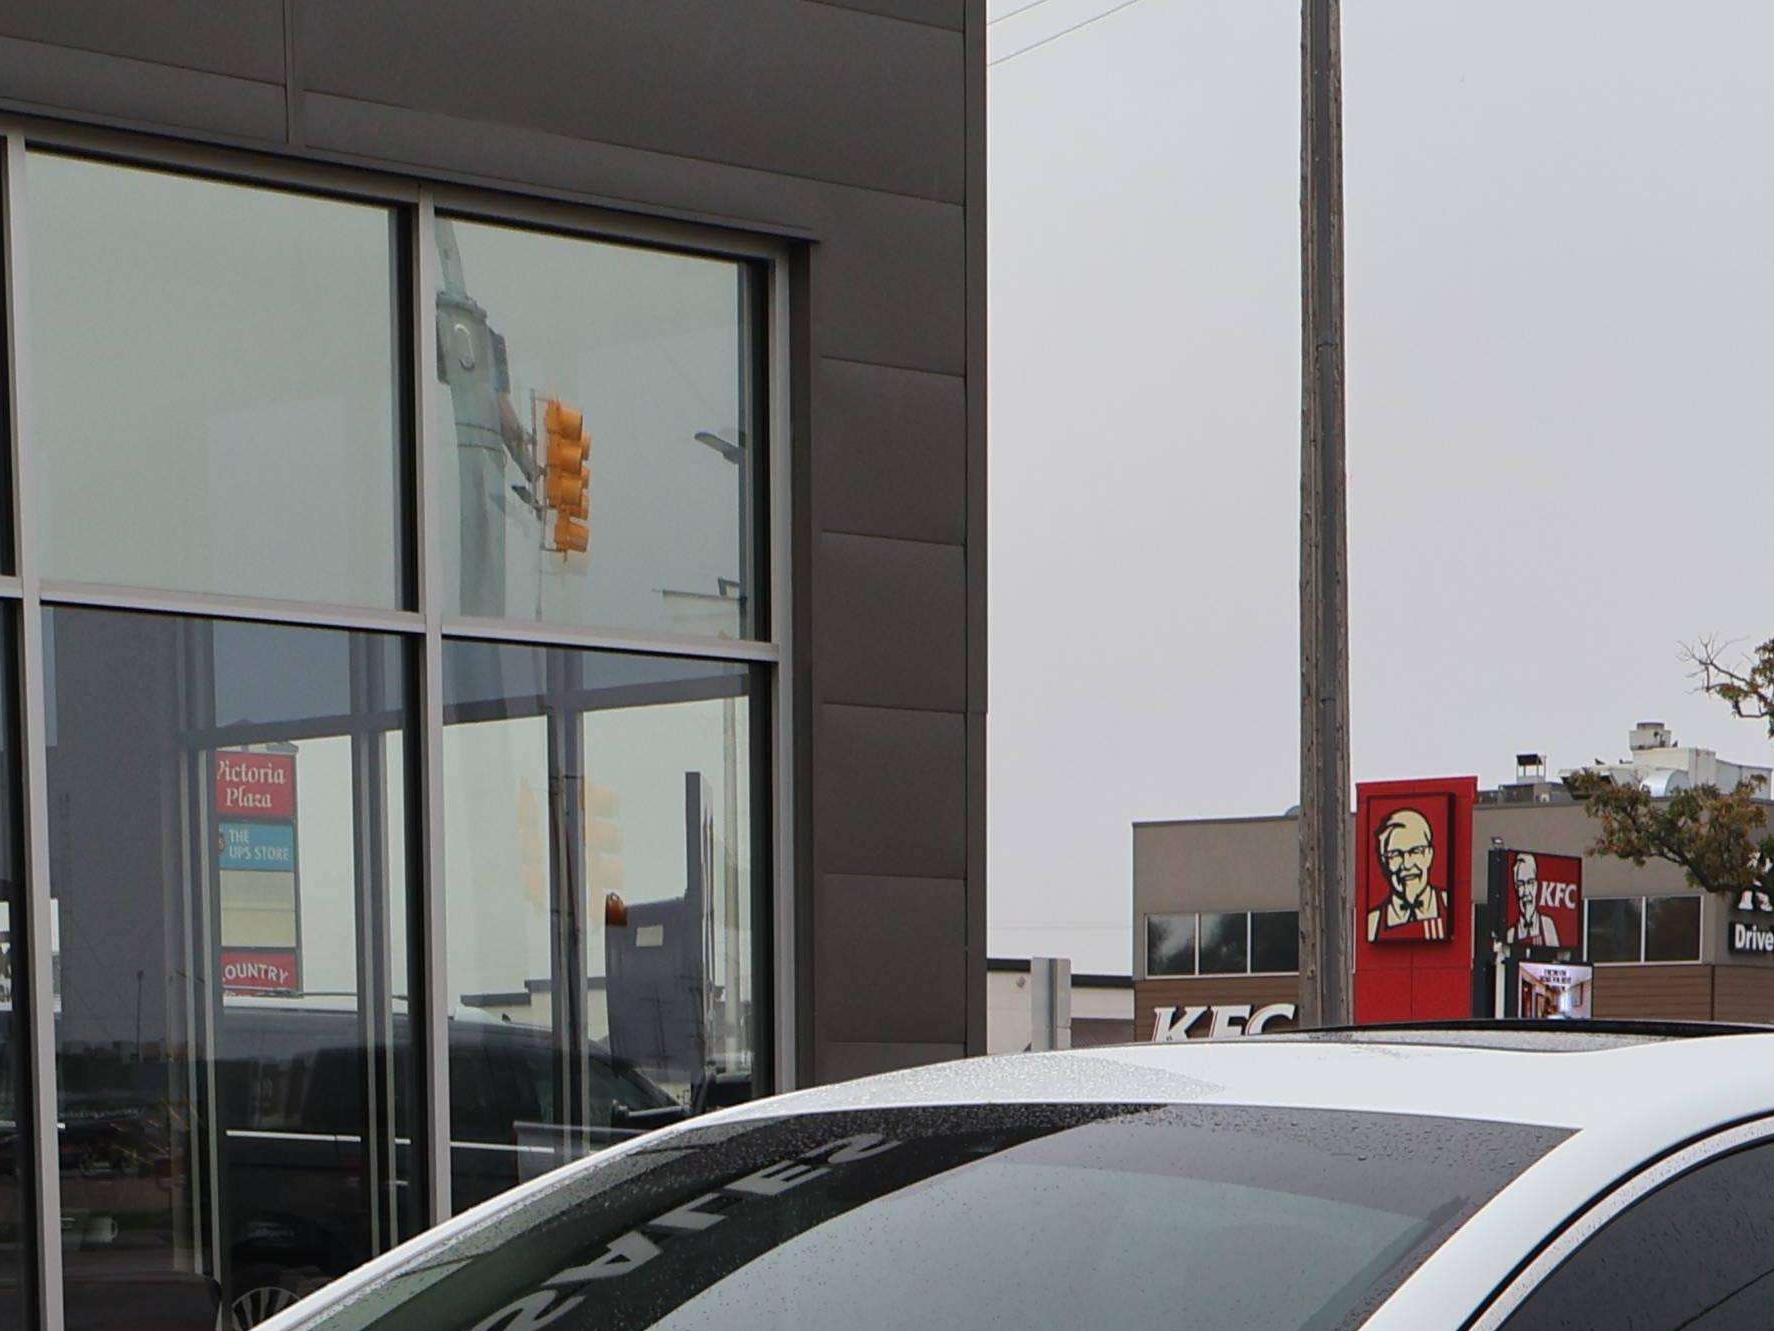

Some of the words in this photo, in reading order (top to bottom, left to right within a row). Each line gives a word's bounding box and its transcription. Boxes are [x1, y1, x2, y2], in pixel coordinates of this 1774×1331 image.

[226, 785, 272, 808] Plaza
[229, 829, 251, 843] THE
[229, 845, 252, 859] UPS
[254, 846, 290, 861] STORE
[1539, 881, 1577, 910] KFC
[1735, 923, 1774, 951] Drive
[1152, 1003, 1296, 1043] KFC
